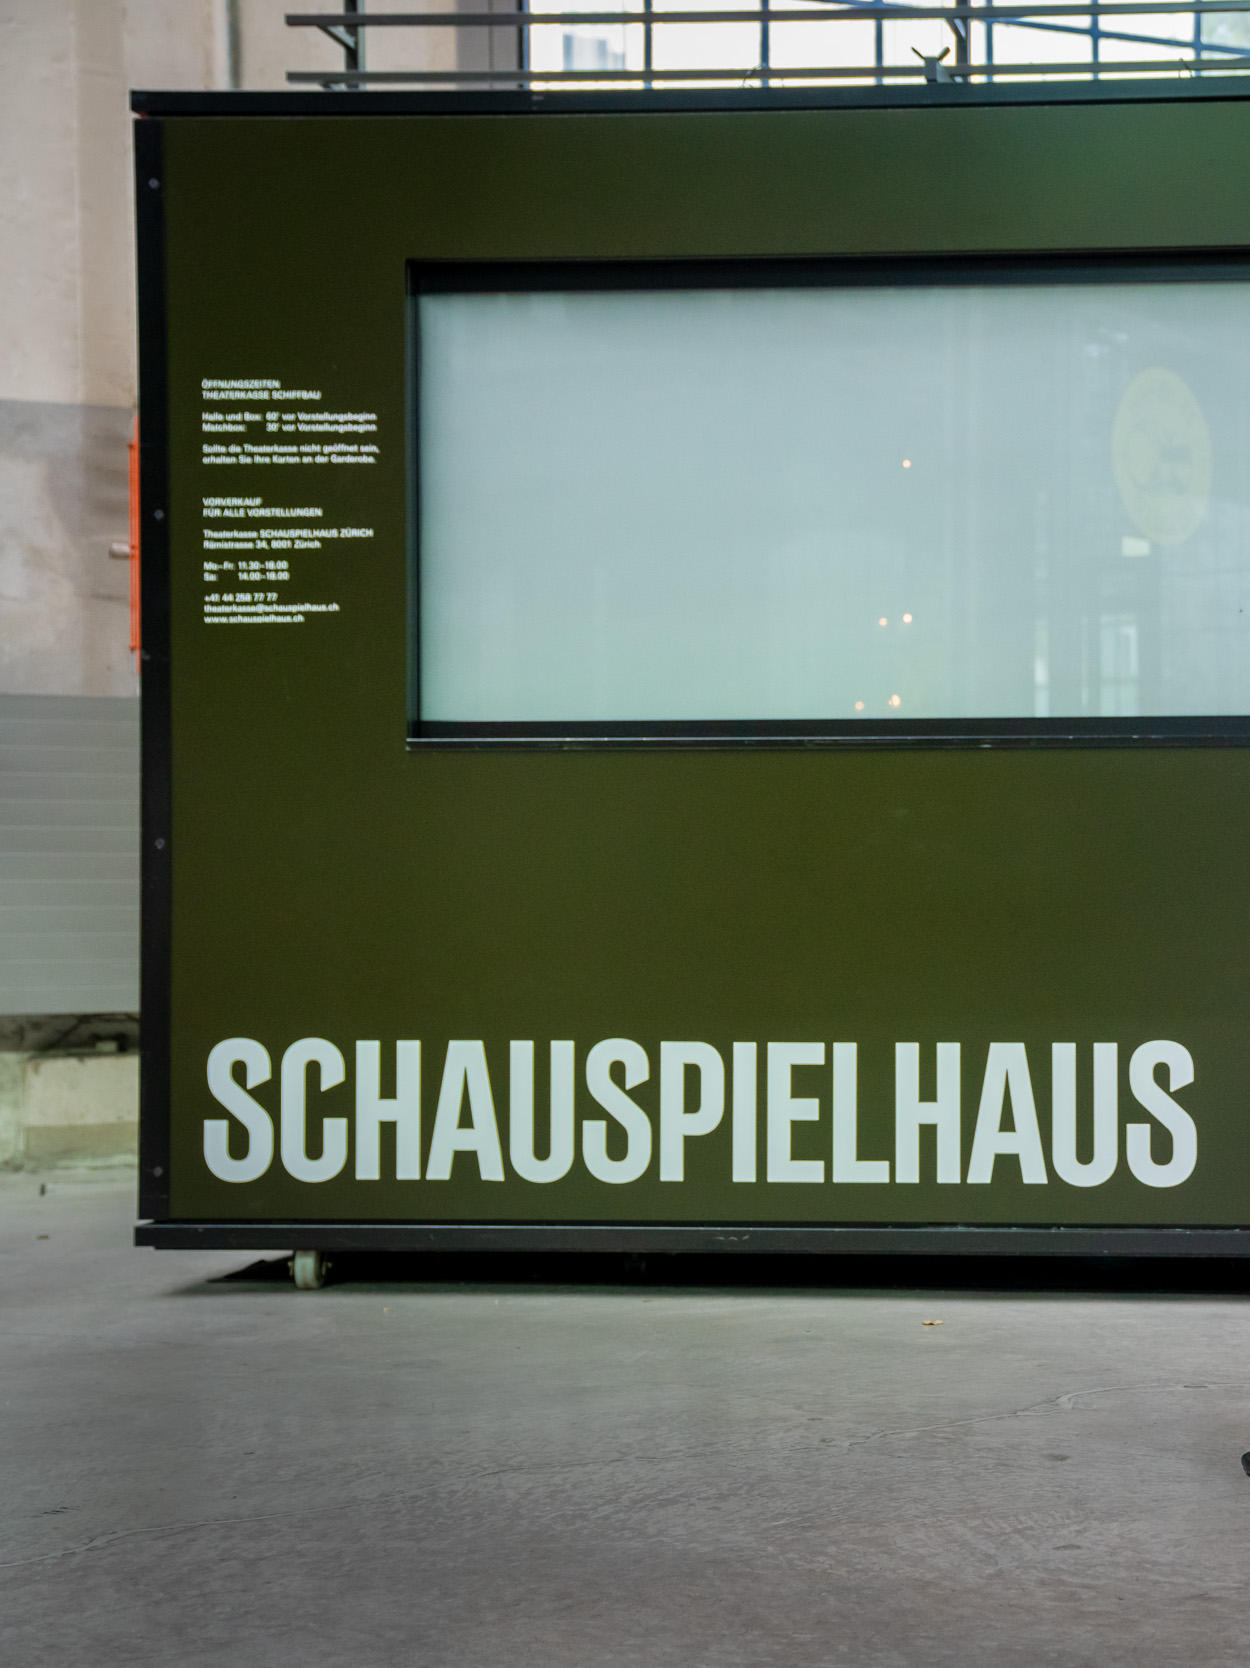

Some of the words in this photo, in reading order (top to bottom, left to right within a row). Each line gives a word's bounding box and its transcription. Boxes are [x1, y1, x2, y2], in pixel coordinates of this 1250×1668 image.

[201, 378, 280, 389] ÖFFNUNGSZEITEN
[202, 390, 270, 400] THEATERKASSE
[271, 390, 322, 400] SCHIFFBAU
[202, 412, 223, 421] Halle
[225, 412, 242, 421] und
[281, 413, 296, 421] vor
[297, 411, 377, 423] Vorstellungsbeginn
[202, 422, 247, 432] Matchbox:
[281, 424, 296, 432] vor
[297, 422, 377, 434] Vorstellungsbeginn
[202, 444, 227, 454] Sollte
[228, 444, 242, 453] die
[243, 443, 298, 453] Theaterkasse
[299, 443, 321, 453] nicht
[322, 443, 358, 455] geöffnet
[202, 455, 237, 464] erhalten
[238, 455, 252, 464] Sie
[253, 455, 271, 464] Ihre
[272, 455, 300, 464] Karten
[302, 456, 313, 464] an
[314, 454, 329, 463] der
[202, 497, 262, 507] VORVERKAUF
[203, 507, 222, 518] FÜR
[222, 508, 245, 517] ALLE
[247, 507, 323, 517] VORSTELLUNGEN
[203, 529, 258, 538] Theaterkasse
[259, 528, 339, 538] SCHAUSPIELHAUS
[339, 527, 374, 538] ZÜRICH
[203, 540, 254, 550] Rämistrasse
[293, 539, 321, 549] Zürich
[221, 593, 234, 602] 44
[204, 603, 340, 614] theaterkasse@schauspielhaus.ch
[204, 614, 305, 624] www.schauspielhaus.ch
[203, 1037, 1198, 1188] SCHAUSPIELHAUS
